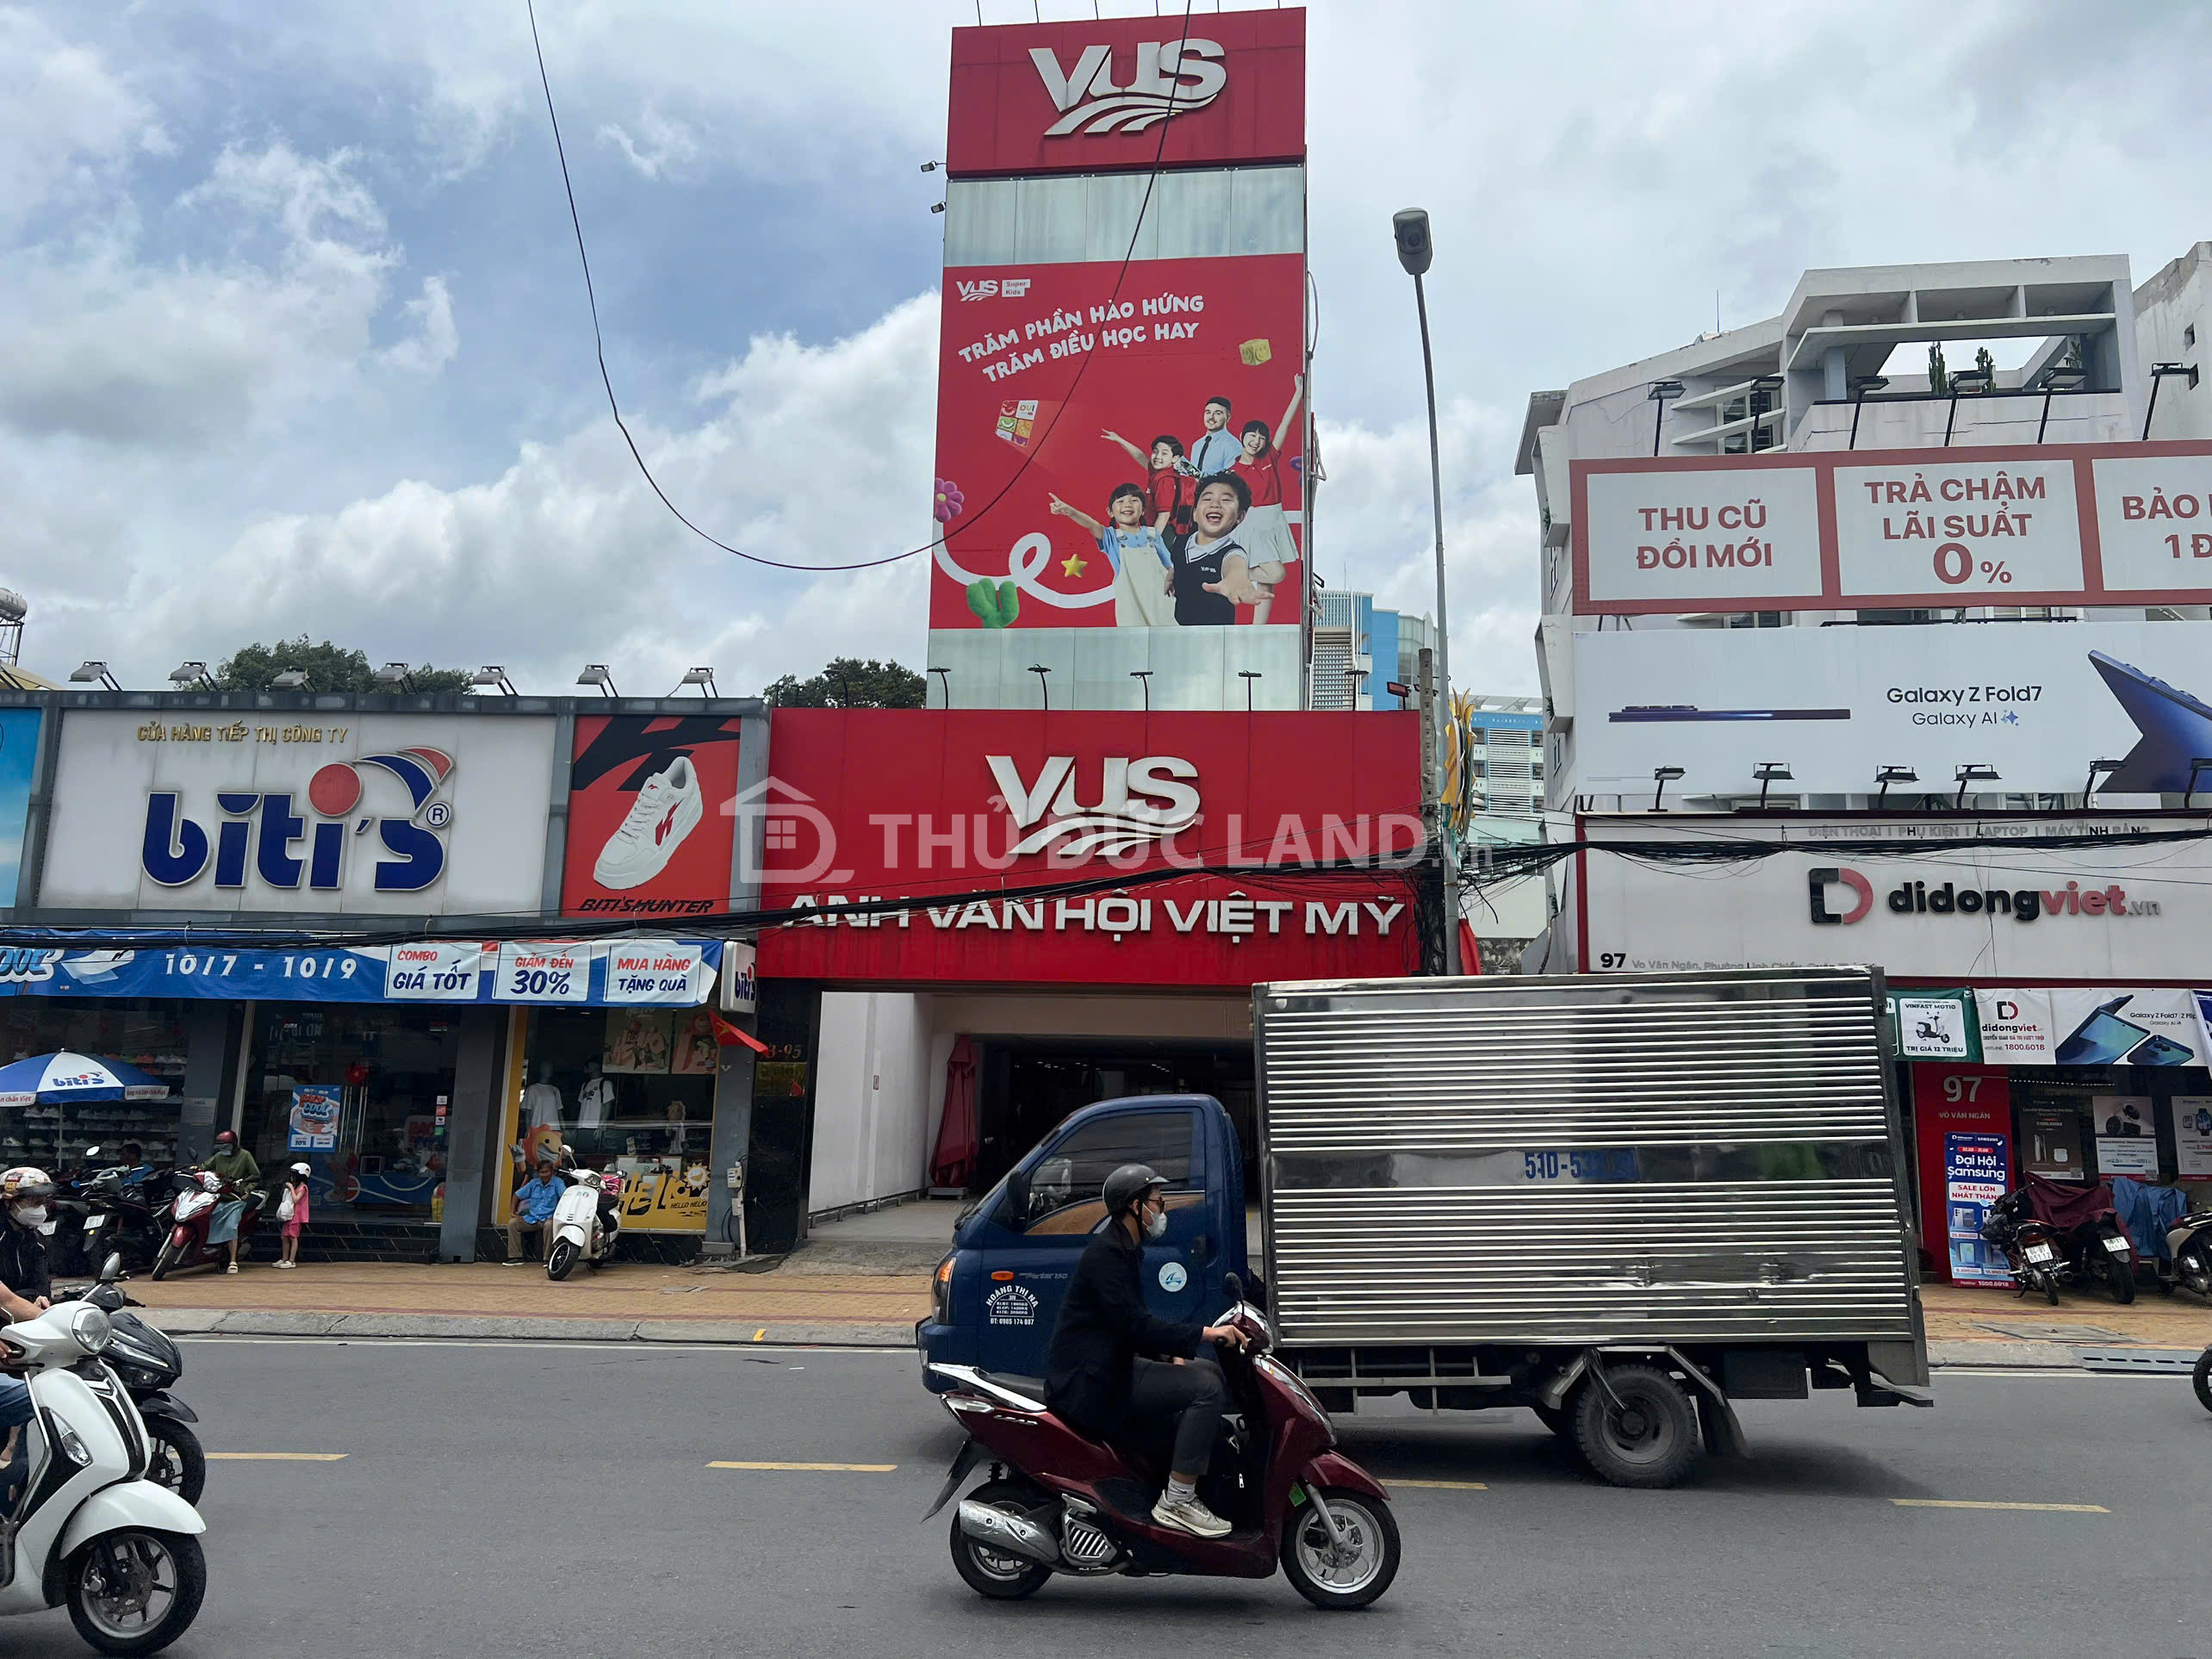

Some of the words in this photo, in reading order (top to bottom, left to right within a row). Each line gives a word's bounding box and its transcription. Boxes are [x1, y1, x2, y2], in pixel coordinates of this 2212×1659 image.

[1028, 38, 1227, 113] VUS
[956, 280, 999, 297] VUS
[958, 329, 1020, 363] TRĂM
[1025, 308, 1083, 340] PHẦN
[1090, 299, 1134, 324] HÀO
[1142, 292, 1204, 316] HỨNG
[982, 348, 1045, 382] TRĂM
[1049, 330, 1095, 359] ĐIỀU
[1103, 326, 1147, 349] HỌC
[1154, 322, 1200, 340] HAY
[1864, 473, 1933, 504] TRẢ
[1940, 471, 2046, 506] CHẬM
[1638, 506, 1710, 531] THU
[1718, 499, 1766, 530] CŨ
[2122, 486, 2200, 520] BẢO
[1883, 510, 1936, 540] LÃI
[1943, 506, 2033, 538] SUẤT
[1636, 537, 1697, 569] ĐỔI
[1706, 536, 1773, 568] MỚI
[2164, 534, 2180, 559] 1
[1886, 687, 1965, 706] Galaxy
[1968, 687, 1981, 702] Z
[1985, 686, 2042, 702] Fold7
[138, 721, 166, 742] CỬA
[171, 723, 212, 742] HÀNG
[217, 719, 249, 742] TIẾP
[255, 726, 277, 744] THỊ
[283, 724, 322, 743] CÔNG
[328, 728, 349, 743] TY
[1912, 712, 1977, 729] Galaxy
[1981, 711, 1998, 724] AI
[985, 755, 1201, 830] VUS
[140, 763, 446, 892] biti's
[1809, 824, 1839, 839] ĐIỆN
[1842, 826, 1881, 839] THOẠI
[1898, 826, 1926, 839] PHỤ
[1929, 824, 1959, 839] KIỆN
[1977, 823, 2029, 836] LAPTOP
[2046, 823, 2074, 836] MÁY
[1888, 880, 2161, 921] didongviet.vn
[783, 895, 910, 928] ANH
[1055, 888, 1151, 941] HỘI
[1164, 891, 1293, 942] VIỆT
[166, 954, 238, 978] 10/7
[283, 956, 357, 979] 10/9
[397, 950, 438, 962] COMBO
[515, 953, 547, 969] GIẢM
[550, 950, 574, 969] ĐẾN
[618, 958, 649, 971] MUA
[653, 954, 691, 971] HÀNG
[1600, 953, 1626, 969] 97
[1649, 960, 1668, 969] Văn
[393, 966, 429, 990] GIÁ
[433, 959, 472, 990] TỐT
[510, 970, 571, 996] 30%
[618, 976, 655, 994] TẶNG
[659, 973, 687, 991] QUÀ
[1943, 1076, 1982, 1103] 97
[1948, 1166, 2005, 1181] Samsung
[1955, 1154, 1975, 1168] Đại
[1978, 1155, 1997, 1169] Hội
[1028, 1294, 1040, 1308] NA
